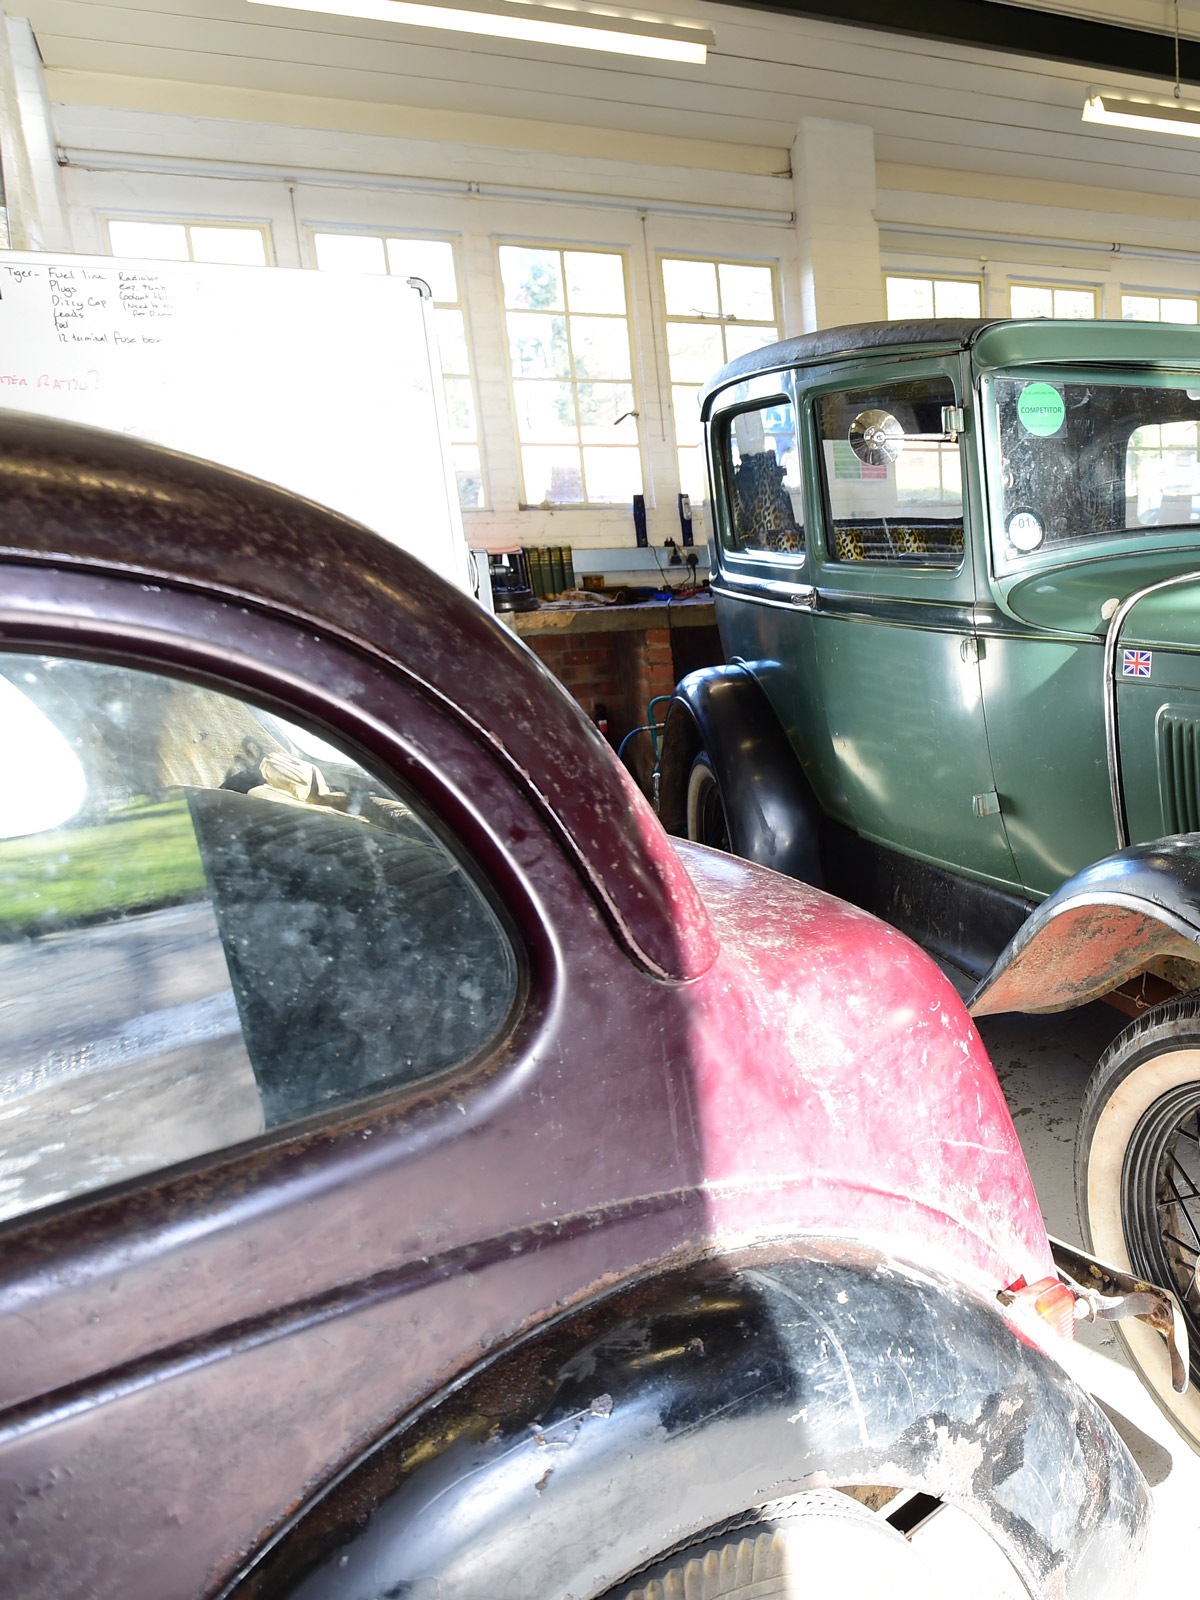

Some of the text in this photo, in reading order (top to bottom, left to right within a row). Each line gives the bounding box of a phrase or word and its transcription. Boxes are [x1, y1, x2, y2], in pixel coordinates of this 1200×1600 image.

[48, 267, 75, 280] Fuel
[82, 269, 107, 280] line
[49, 279, 77, 299] Plugs
[51, 294, 107, 311] Dizzy Cap
[53, 308, 84, 319] Leads
[58, 333, 69, 343] 12
[72, 331, 108, 343] terminal
[141, 334, 162, 344] box
[1018, 517, 1031, 528] 01
